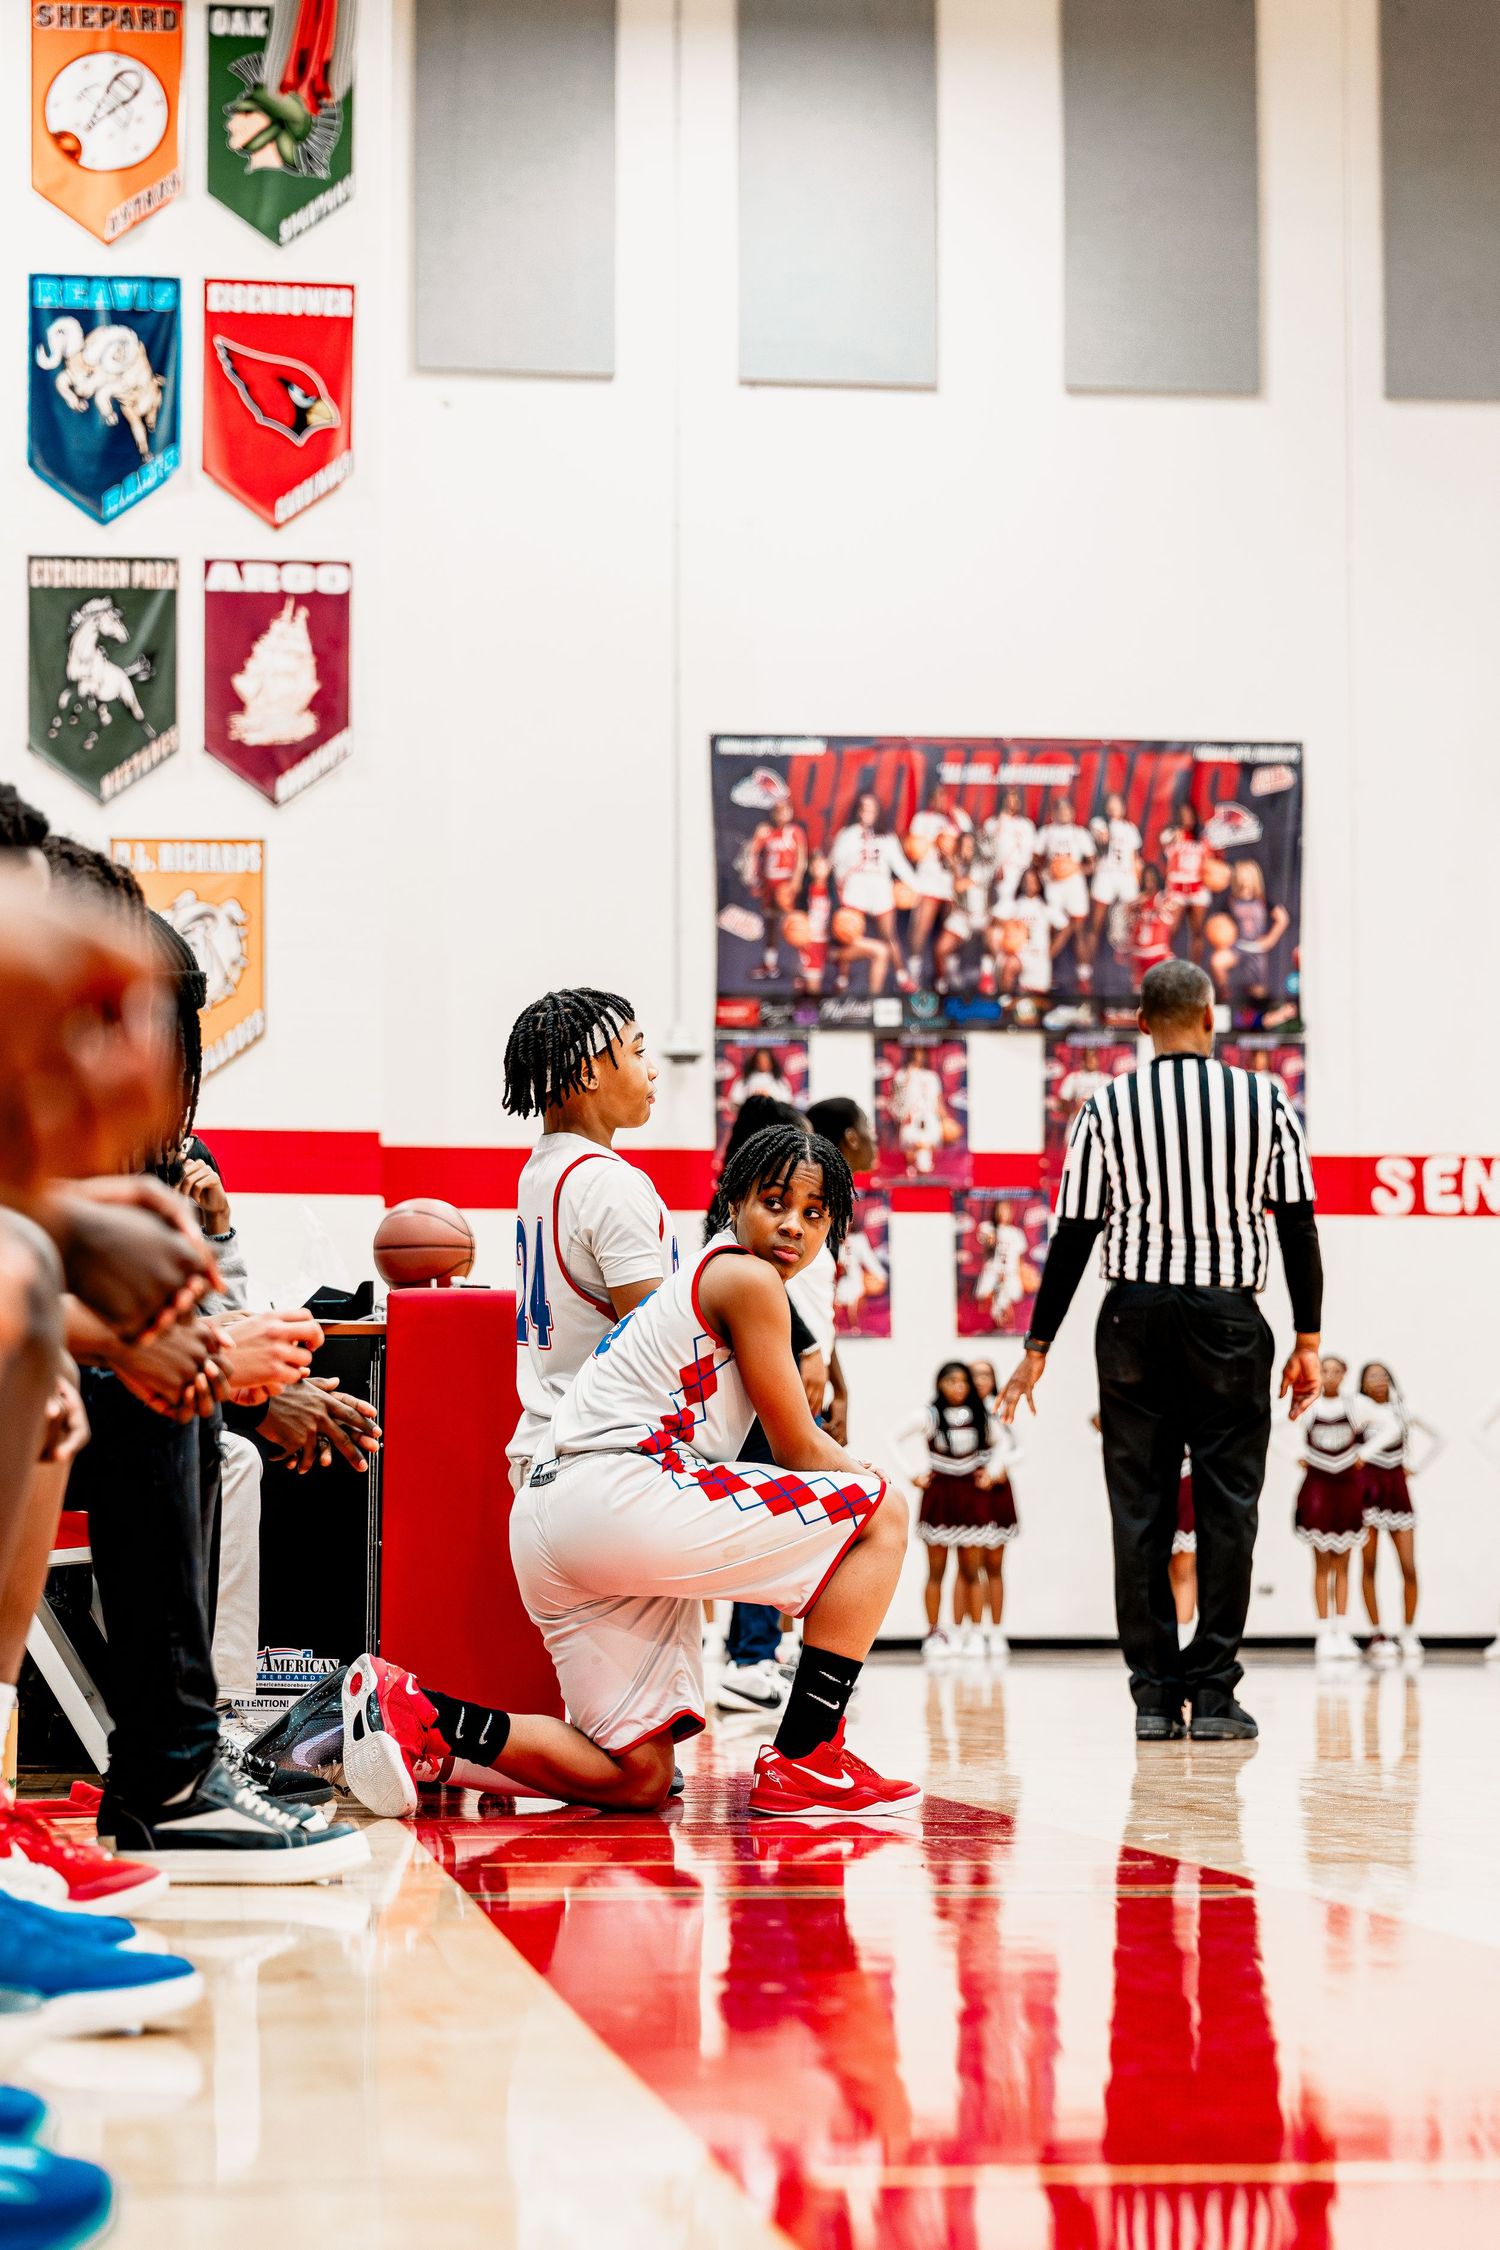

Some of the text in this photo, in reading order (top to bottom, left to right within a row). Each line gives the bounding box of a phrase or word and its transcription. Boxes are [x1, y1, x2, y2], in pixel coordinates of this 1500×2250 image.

[35, 4, 180, 31] SHEPARD
[210, 9, 268, 36] OAK
[33, 276, 178, 311] REAVIS
[205, 561, 350, 595] ARGO
[1371, 1156, 1500, 1216] SEN
[261, 1647, 339, 1673] AMERICAN
[234, 1699, 289, 1708] ATTENTION!
